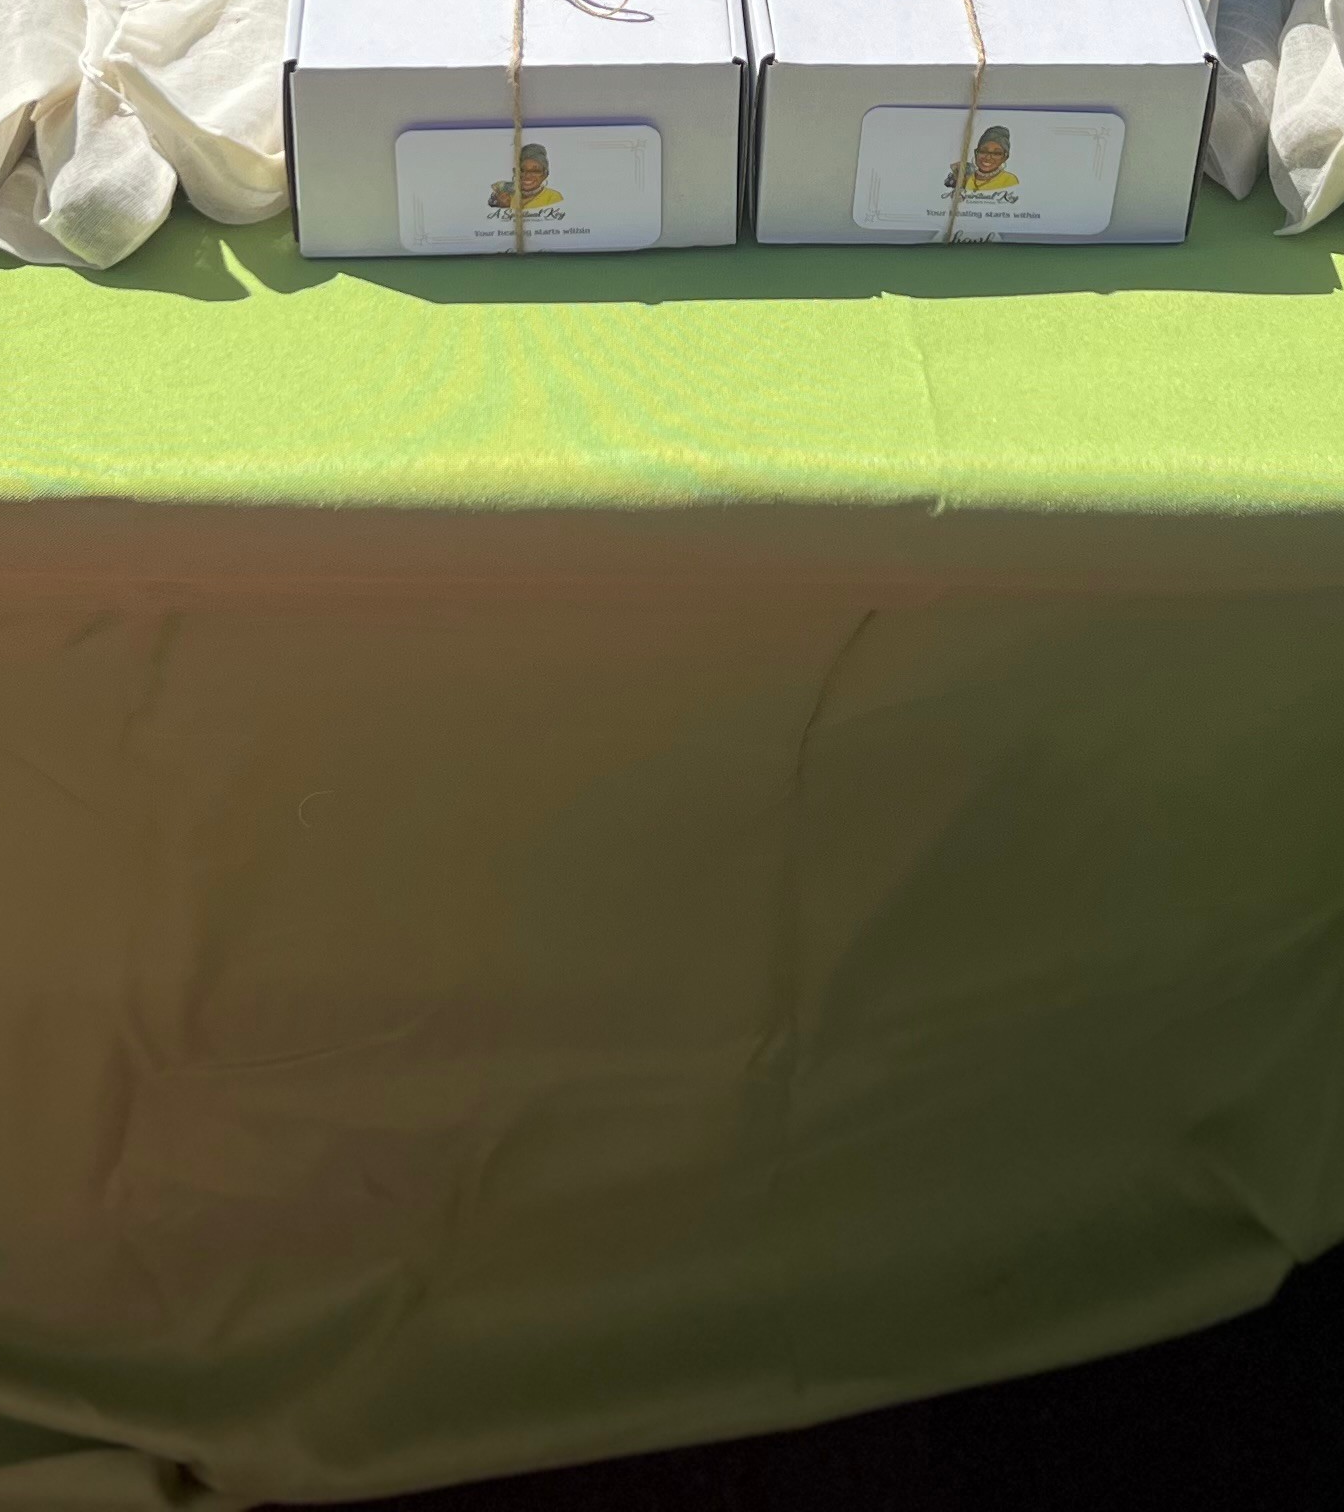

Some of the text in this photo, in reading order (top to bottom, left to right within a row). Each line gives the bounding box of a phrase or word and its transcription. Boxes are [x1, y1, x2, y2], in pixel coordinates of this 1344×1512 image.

[487, 208, 501, 220] A
[542, 207, 566, 221] Key
[985, 211, 1011, 219] starts
[1013, 212, 1041, 220] within
[534, 228, 561, 236] starts
[563, 226, 591, 235] within
